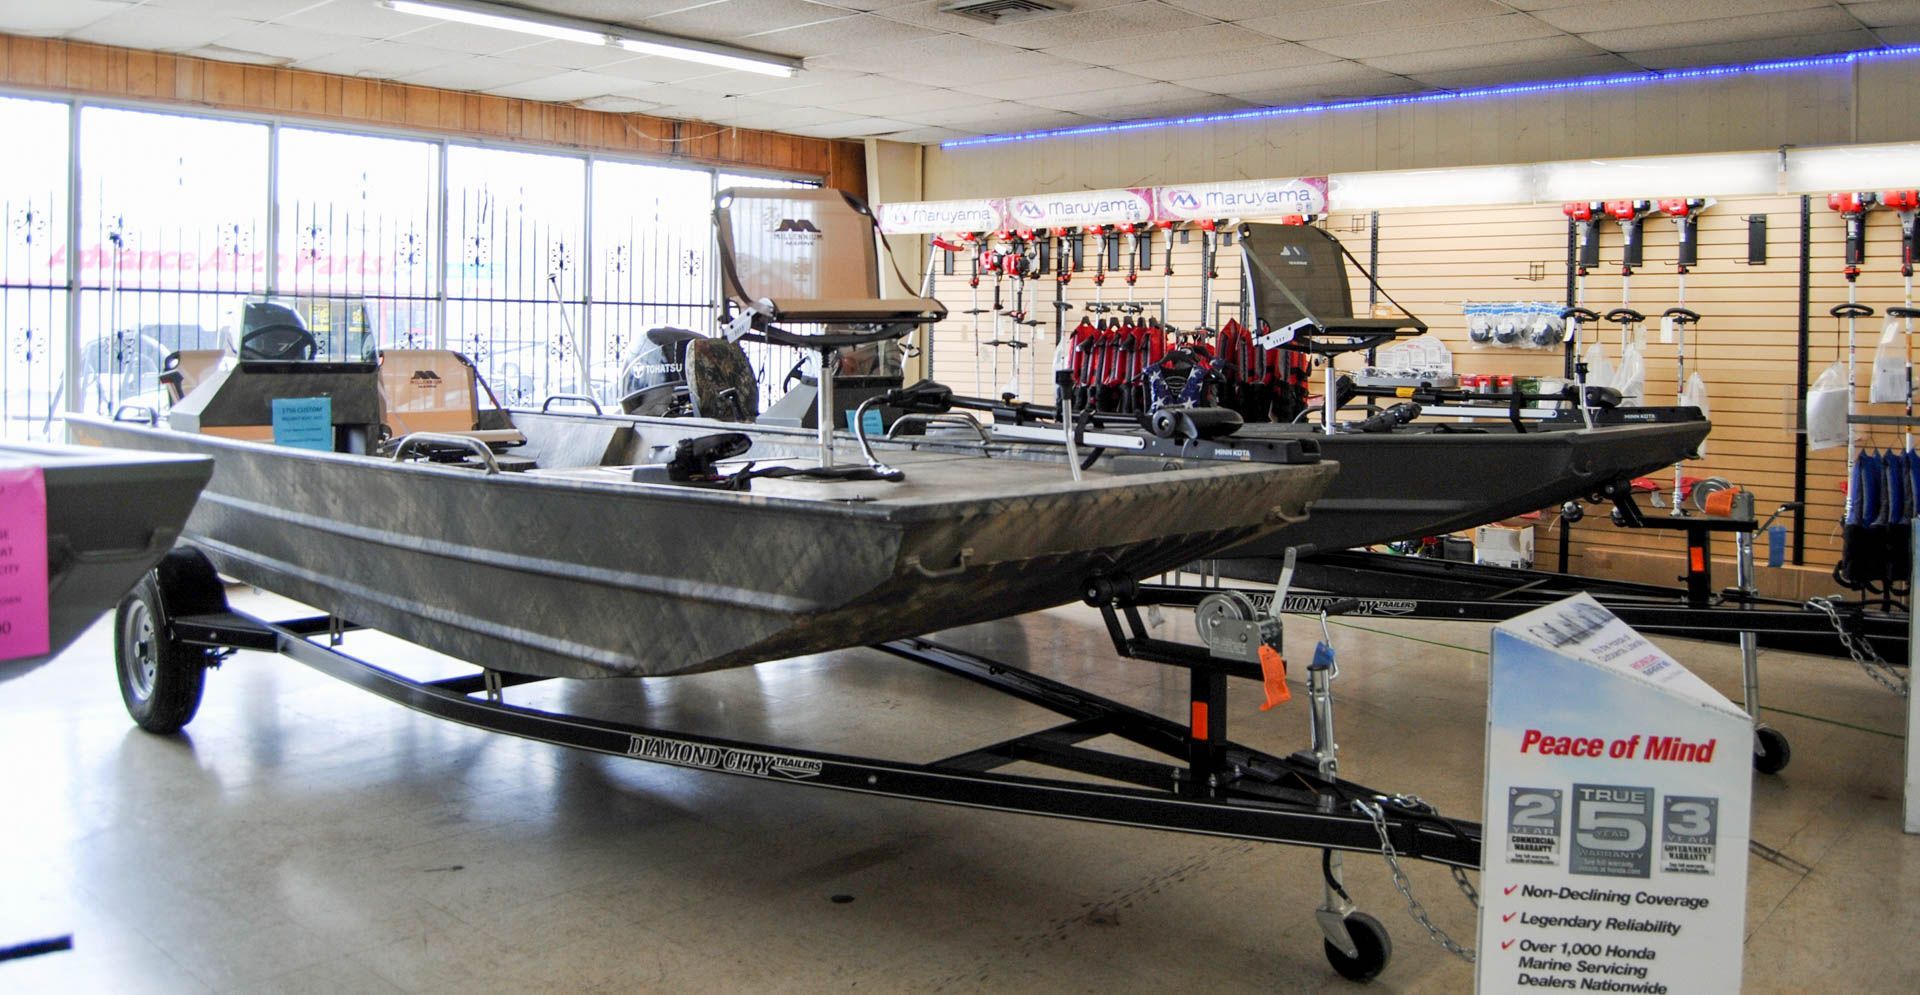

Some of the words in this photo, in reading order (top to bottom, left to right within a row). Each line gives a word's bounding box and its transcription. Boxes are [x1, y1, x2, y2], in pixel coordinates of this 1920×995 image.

[645, 362, 683, 375] TOHATSU
[1214, 448, 1233, 456] MINN
[1232, 449, 1251, 457] KOTA
[1377, 600, 1418, 609] TRAILERS
[1520, 729, 1605, 757] Peace
[1609, 735, 1641, 759] of
[1643, 735, 1717, 763] Mind
[628, 735, 722, 768] DIAMOND
[722, 749, 774, 776] CITY
[774, 757, 823, 772] TRAILERS
[1580, 788, 1647, 803] TRUE
[1513, 794, 1556, 827] 2
[1576, 800, 1646, 851] 5
[1668, 802, 1711, 836] 3
[1513, 826, 1554, 835] YEAR
[1597, 830, 1628, 840] YEAR
[1511, 835, 1556, 845] COMMERCIAL
[1668, 835, 1709, 844] YEAR
[1514, 843, 1552, 853] WARRANTY
[1580, 849, 1645, 859] WARRANTY
[1664, 845, 1712, 854] GOVERNMENT
[1669, 853, 1708, 861] WARRANTY
[1521, 885, 1632, 906] Non-Declining
[1635, 891, 1709, 910] Coverage
[1520, 911, 1602, 932] Legendary
[1605, 917, 1682, 937] Reliability
[1519, 939, 1557, 953] Over
[1561, 942, 1601, 957] 1,000
[1605, 944, 1656, 960] Honda
[1518, 956, 1572, 972] Marine
[1576, 960, 1648, 979] Servicing
[1517, 973, 1576, 989] Dealers
[1580, 978, 1668, 995] Nationwide
